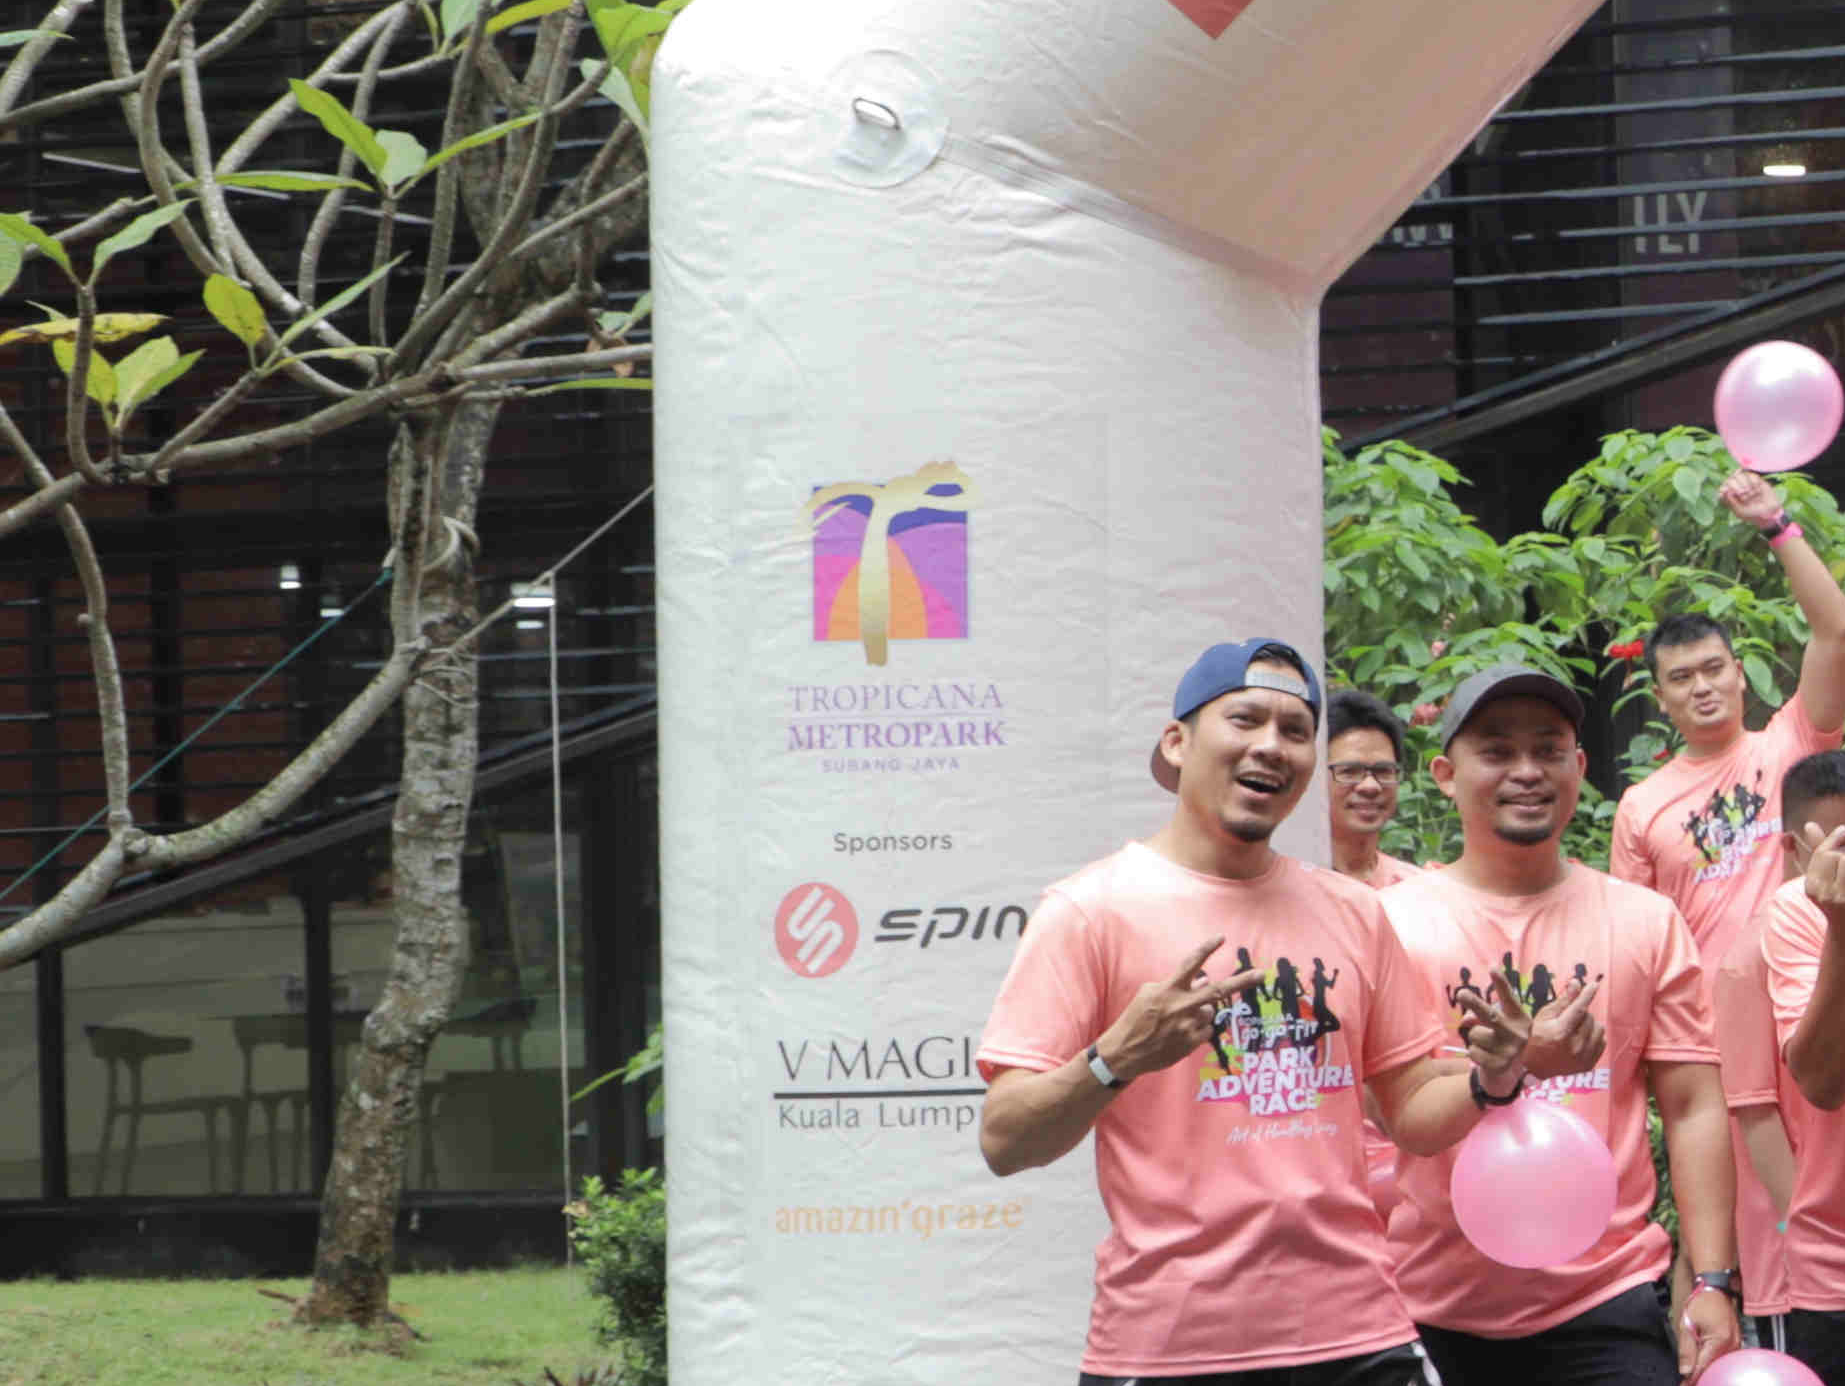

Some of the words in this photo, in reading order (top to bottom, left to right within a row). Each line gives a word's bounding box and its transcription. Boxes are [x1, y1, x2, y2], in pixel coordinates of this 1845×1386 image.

[788, 682, 1005, 712] TROPICANA
[788, 720, 1008, 751] METROPARK
[821, 758, 901, 773] SUBANG
[911, 756, 961, 772] JAYA
[832, 831, 954, 856] Sponsors
[777, 1039, 809, 1081] V
[826, 1036, 973, 1082] MAGI
[1243, 1045, 1317, 1074] PARK
[1196, 1063, 1355, 1102] ADVENTURE
[778, 1099, 861, 1130] Kuala
[879, 1101, 980, 1134] Lump
[1250, 1088, 1318, 1116] RACE
